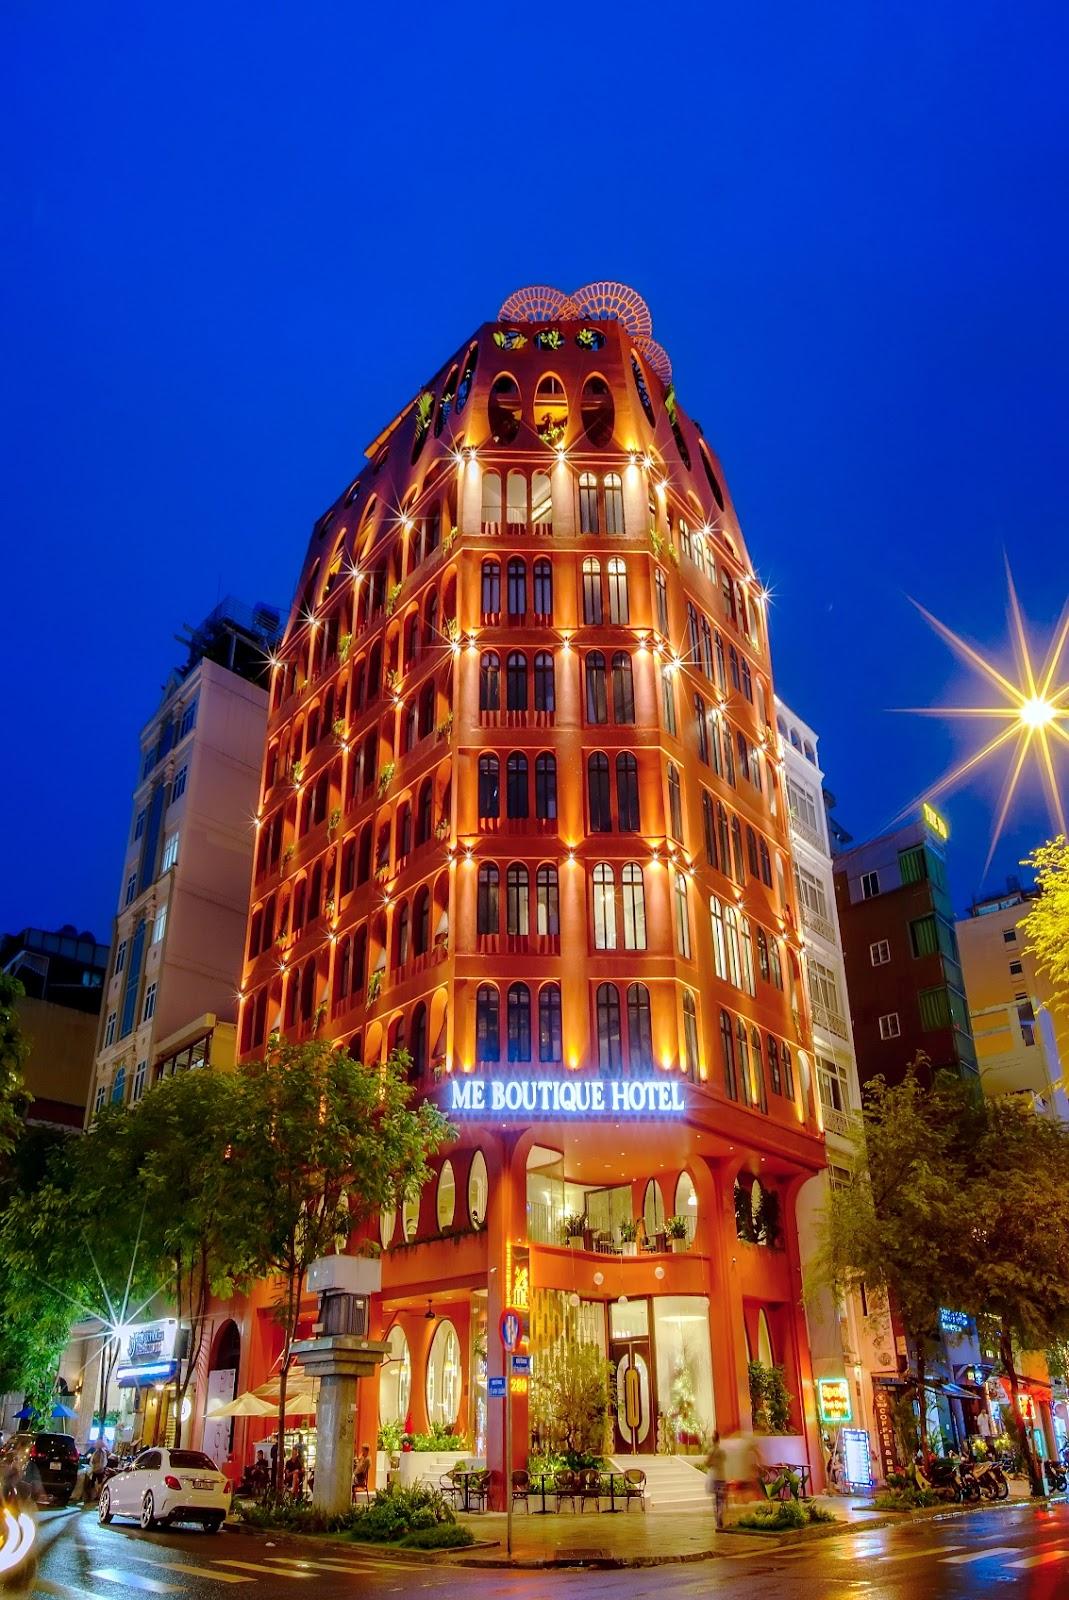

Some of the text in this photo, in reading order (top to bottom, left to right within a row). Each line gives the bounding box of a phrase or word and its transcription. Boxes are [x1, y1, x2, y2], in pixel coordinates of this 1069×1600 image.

[451, 1080, 685, 1111] ME BOUTIQUE HOTEL
[510, 1378, 528, 1393] 280
